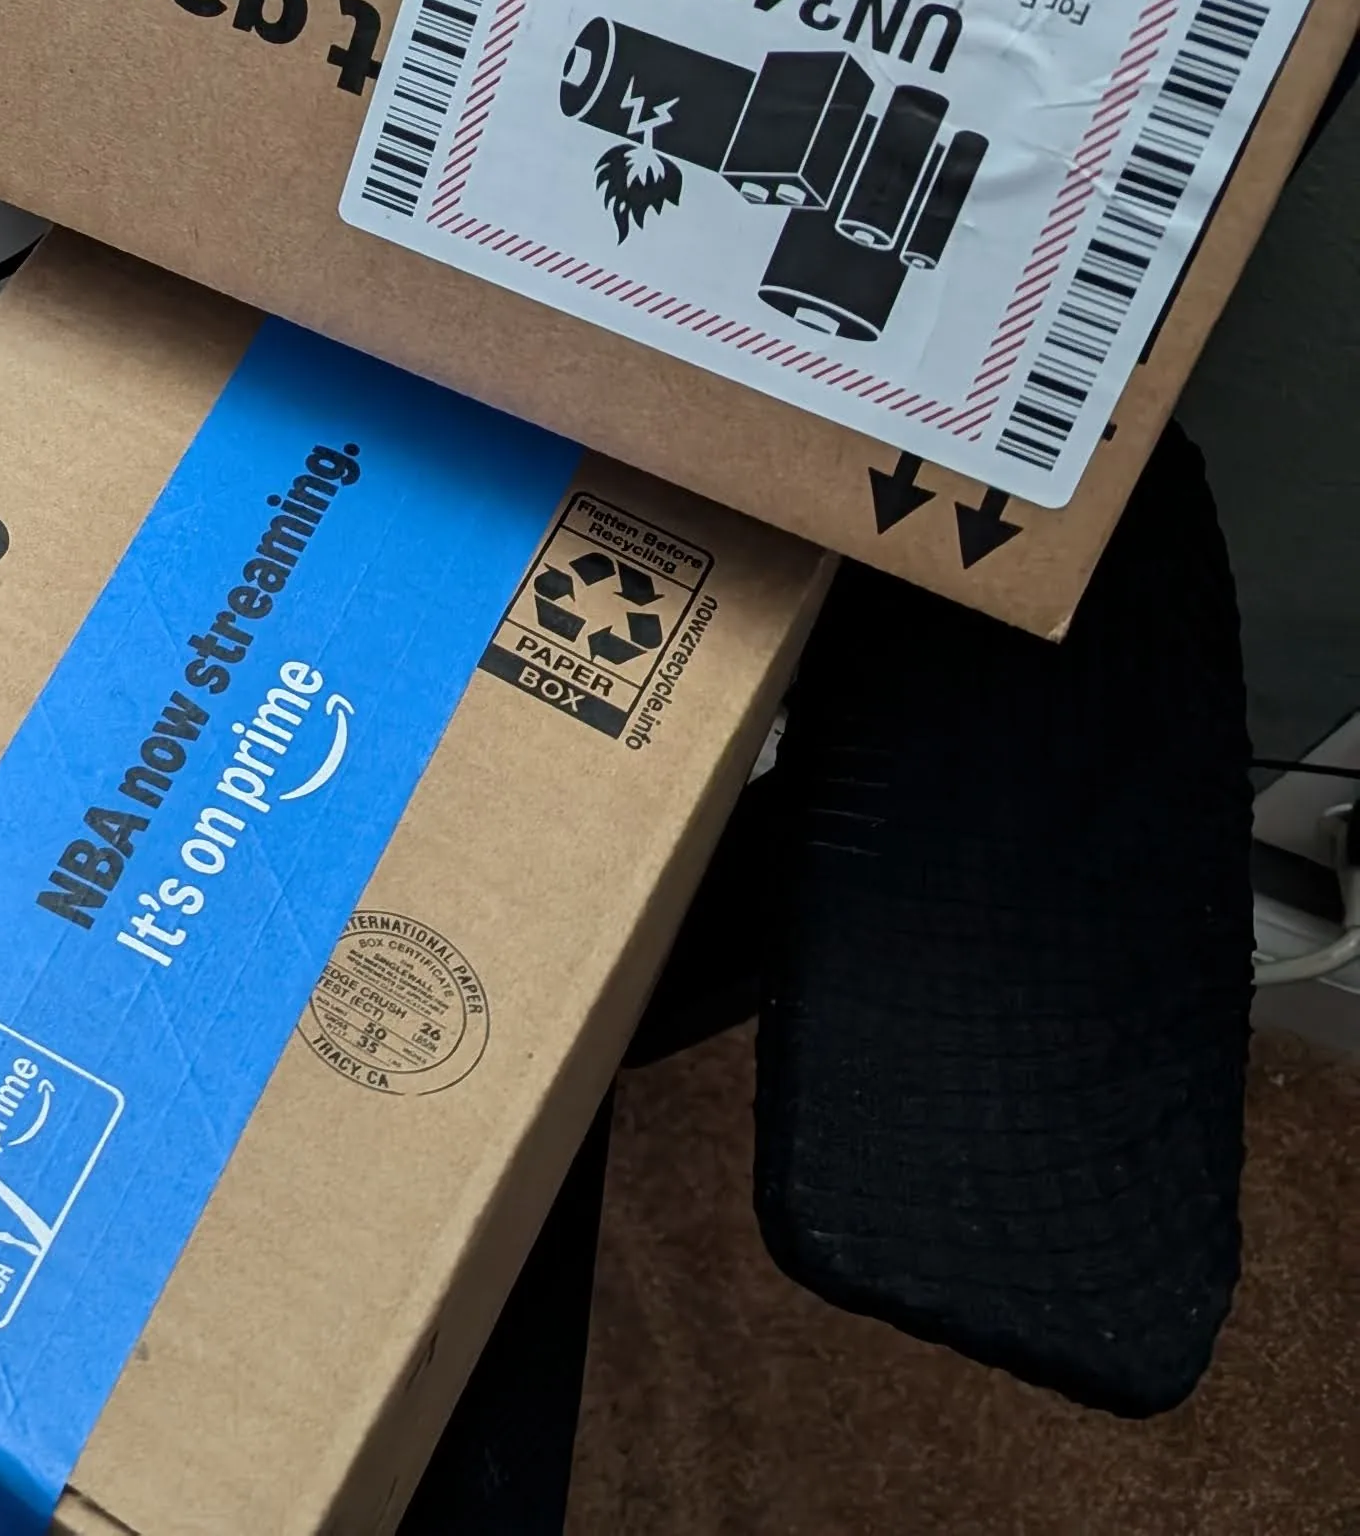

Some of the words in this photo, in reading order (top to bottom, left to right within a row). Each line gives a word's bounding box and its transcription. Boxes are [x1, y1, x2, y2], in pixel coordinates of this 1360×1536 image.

[576, 498, 638, 539] Flatten
[641, 531, 704, 571] Before
[587, 521, 678, 575] Recycling
[35, 804, 151, 931] NBA
[117, 689, 211, 810] now
[184, 441, 362, 696] streaming.
[514, 634, 616, 698] PAPER
[517, 665, 587, 713] BOX
[115, 878, 206, 968] It's
[180, 806, 247, 876] on
[216, 659, 324, 814] prime
[344, 914, 456, 965] TERNATIONAL
[452, 964, 484, 1015] PAPER
[358, 937, 385, 949] BOX
[387, 939, 455, 999] CERTIFICATE
[372, 952, 435, 993] SINGLEWALL
[323, 964, 358, 992] EDGE
[359, 985, 408, 1020] CRUSH
[348, 993, 385, 1022] (ECT)
[355, 1035, 381, 1055] 35
[363, 1021, 388, 1041] 50
[419, 1021, 442, 1041] 26
[366, 1069, 391, 1089] CA
